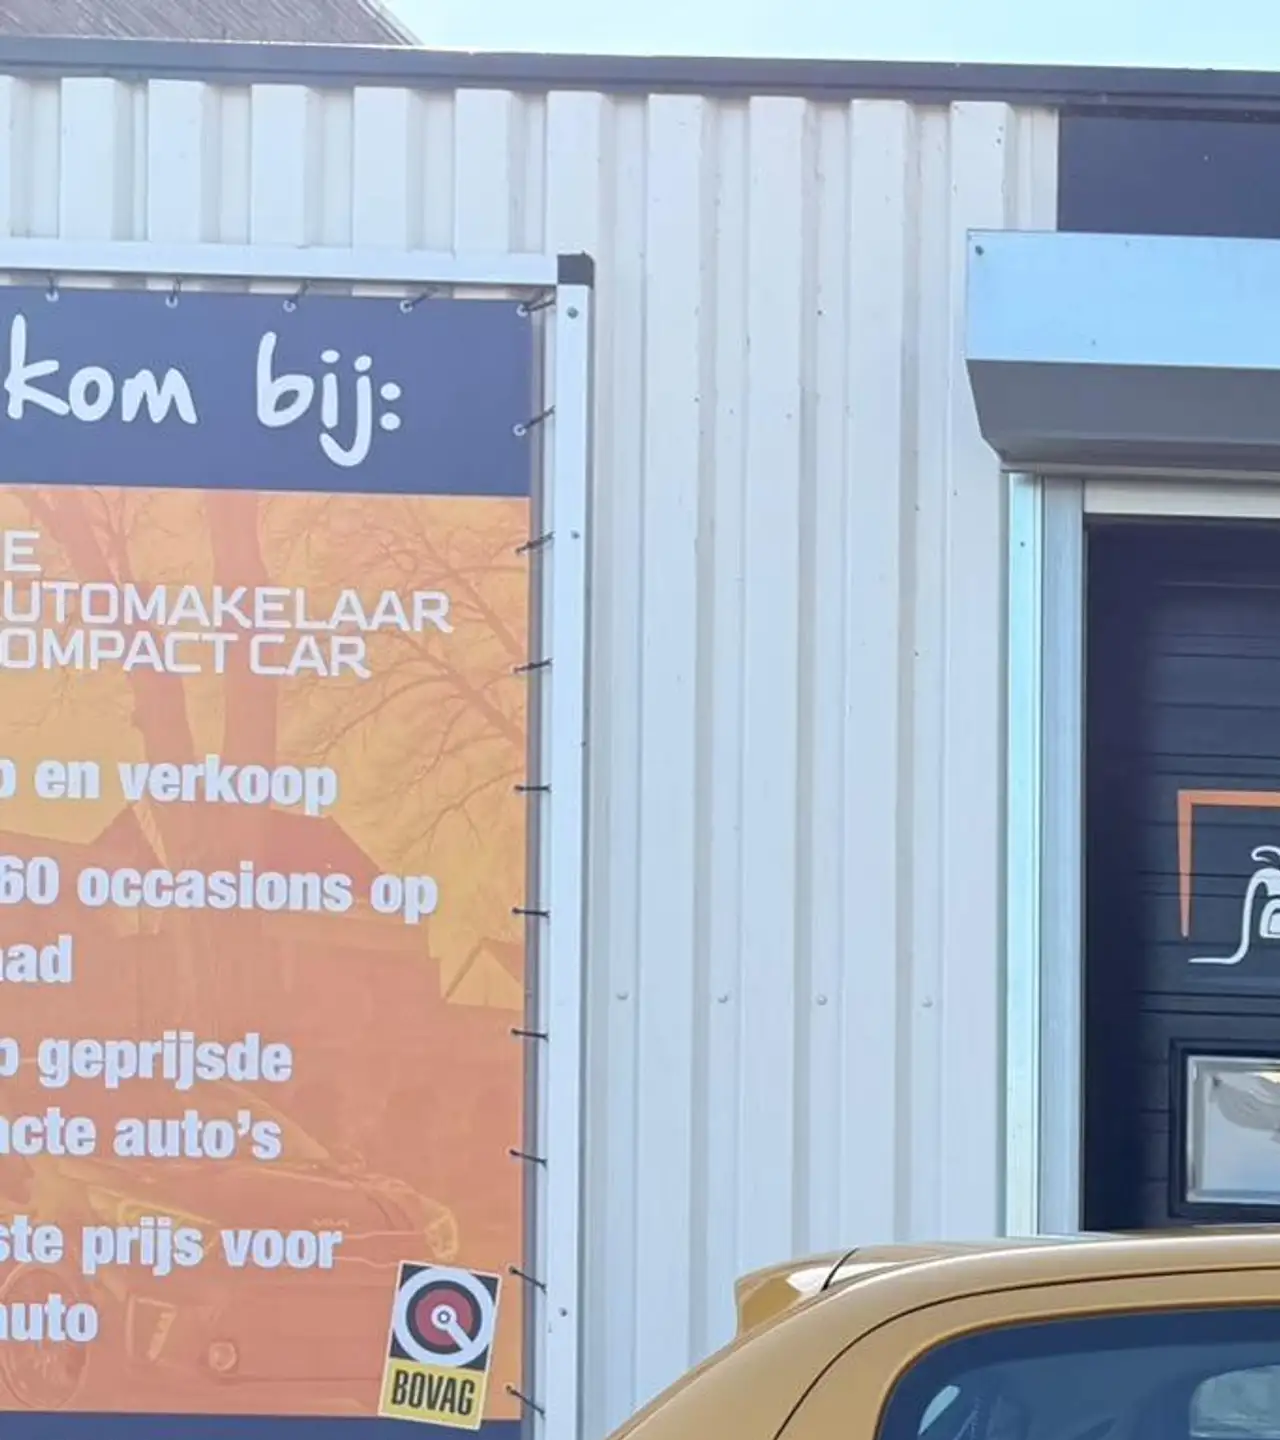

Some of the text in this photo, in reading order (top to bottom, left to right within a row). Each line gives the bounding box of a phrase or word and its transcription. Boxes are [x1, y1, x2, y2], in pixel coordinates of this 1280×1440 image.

[4, 314, 401, 466] kom bij:
[250, 635, 372, 679] CAR
[35, 760, 100, 799] en
[117, 754, 337, 816] verkoop
[77, 860, 352, 912] occasions
[371, 873, 437, 924] op
[0, 934, 73, 983] ad
[37, 1030, 293, 1091] geprijsde
[0, 1107, 97, 1156] cte
[82, 1216, 204, 1276] prijs
[221, 1229, 343, 1268] voor
[0, 1293, 98, 1342] uto
[391, 1369, 475, 1416] BOVAG
